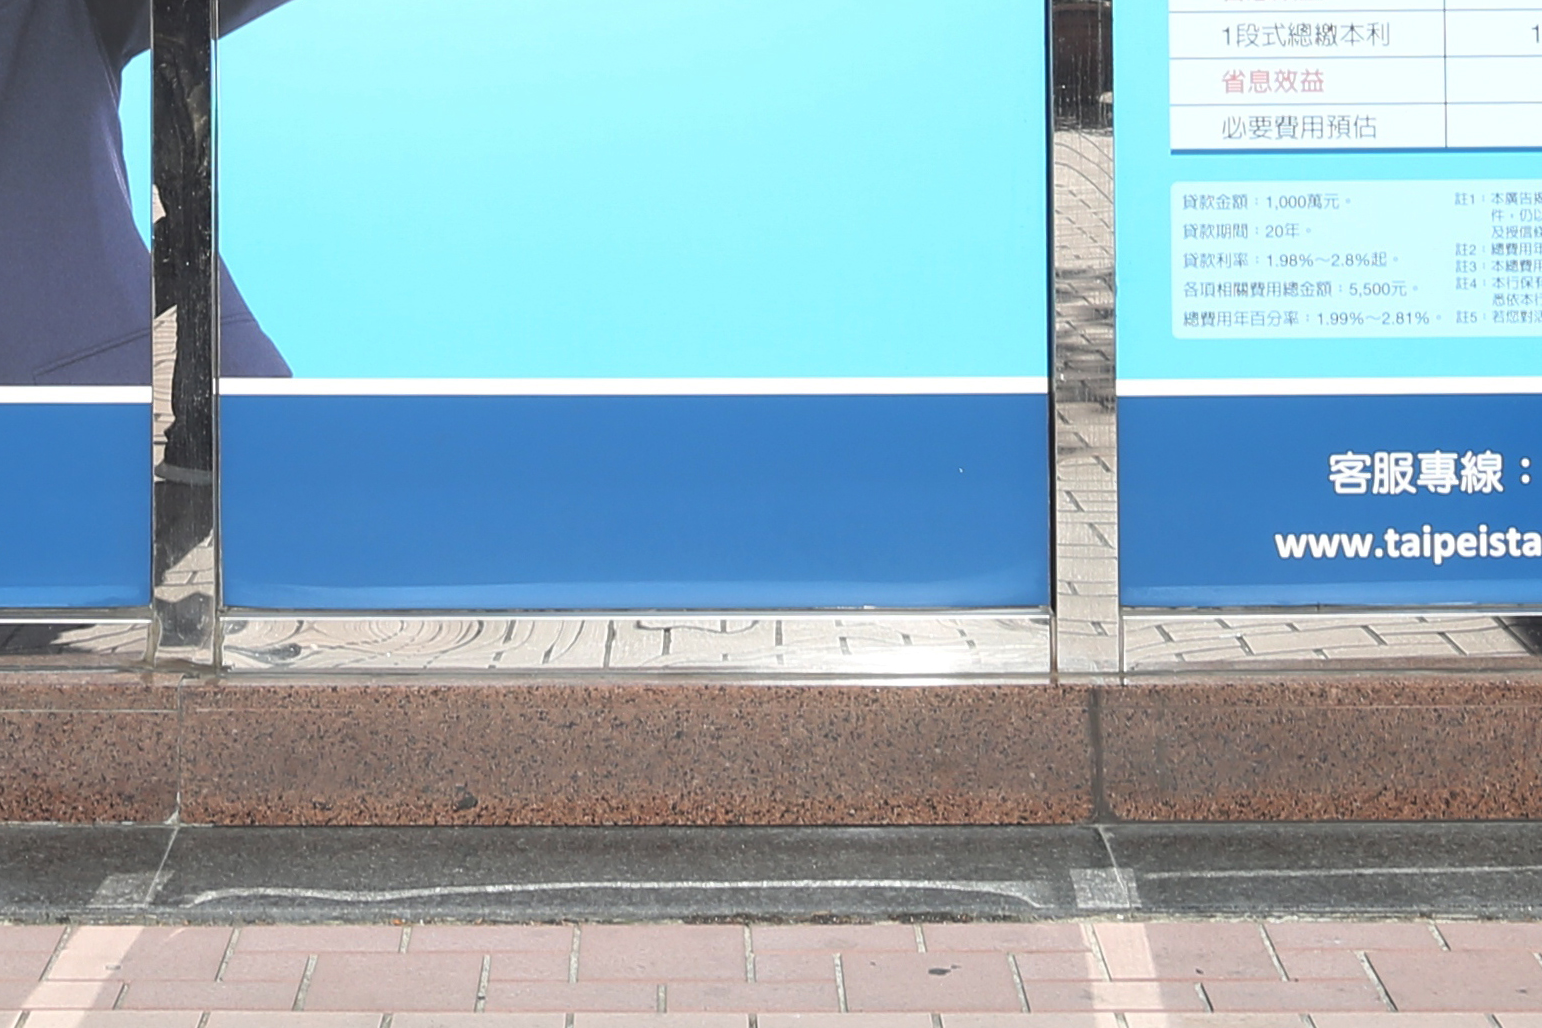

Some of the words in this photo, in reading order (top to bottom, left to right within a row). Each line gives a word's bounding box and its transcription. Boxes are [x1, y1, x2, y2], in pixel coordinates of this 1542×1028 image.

[1222, 22, 1390, 47] 1段式總繳本利
[1221, 69, 1325, 94] 省息效益
[1221, 115, 1377, 140] 必要費用預估
[1274, 524, 1542, 565] www.taipeista
